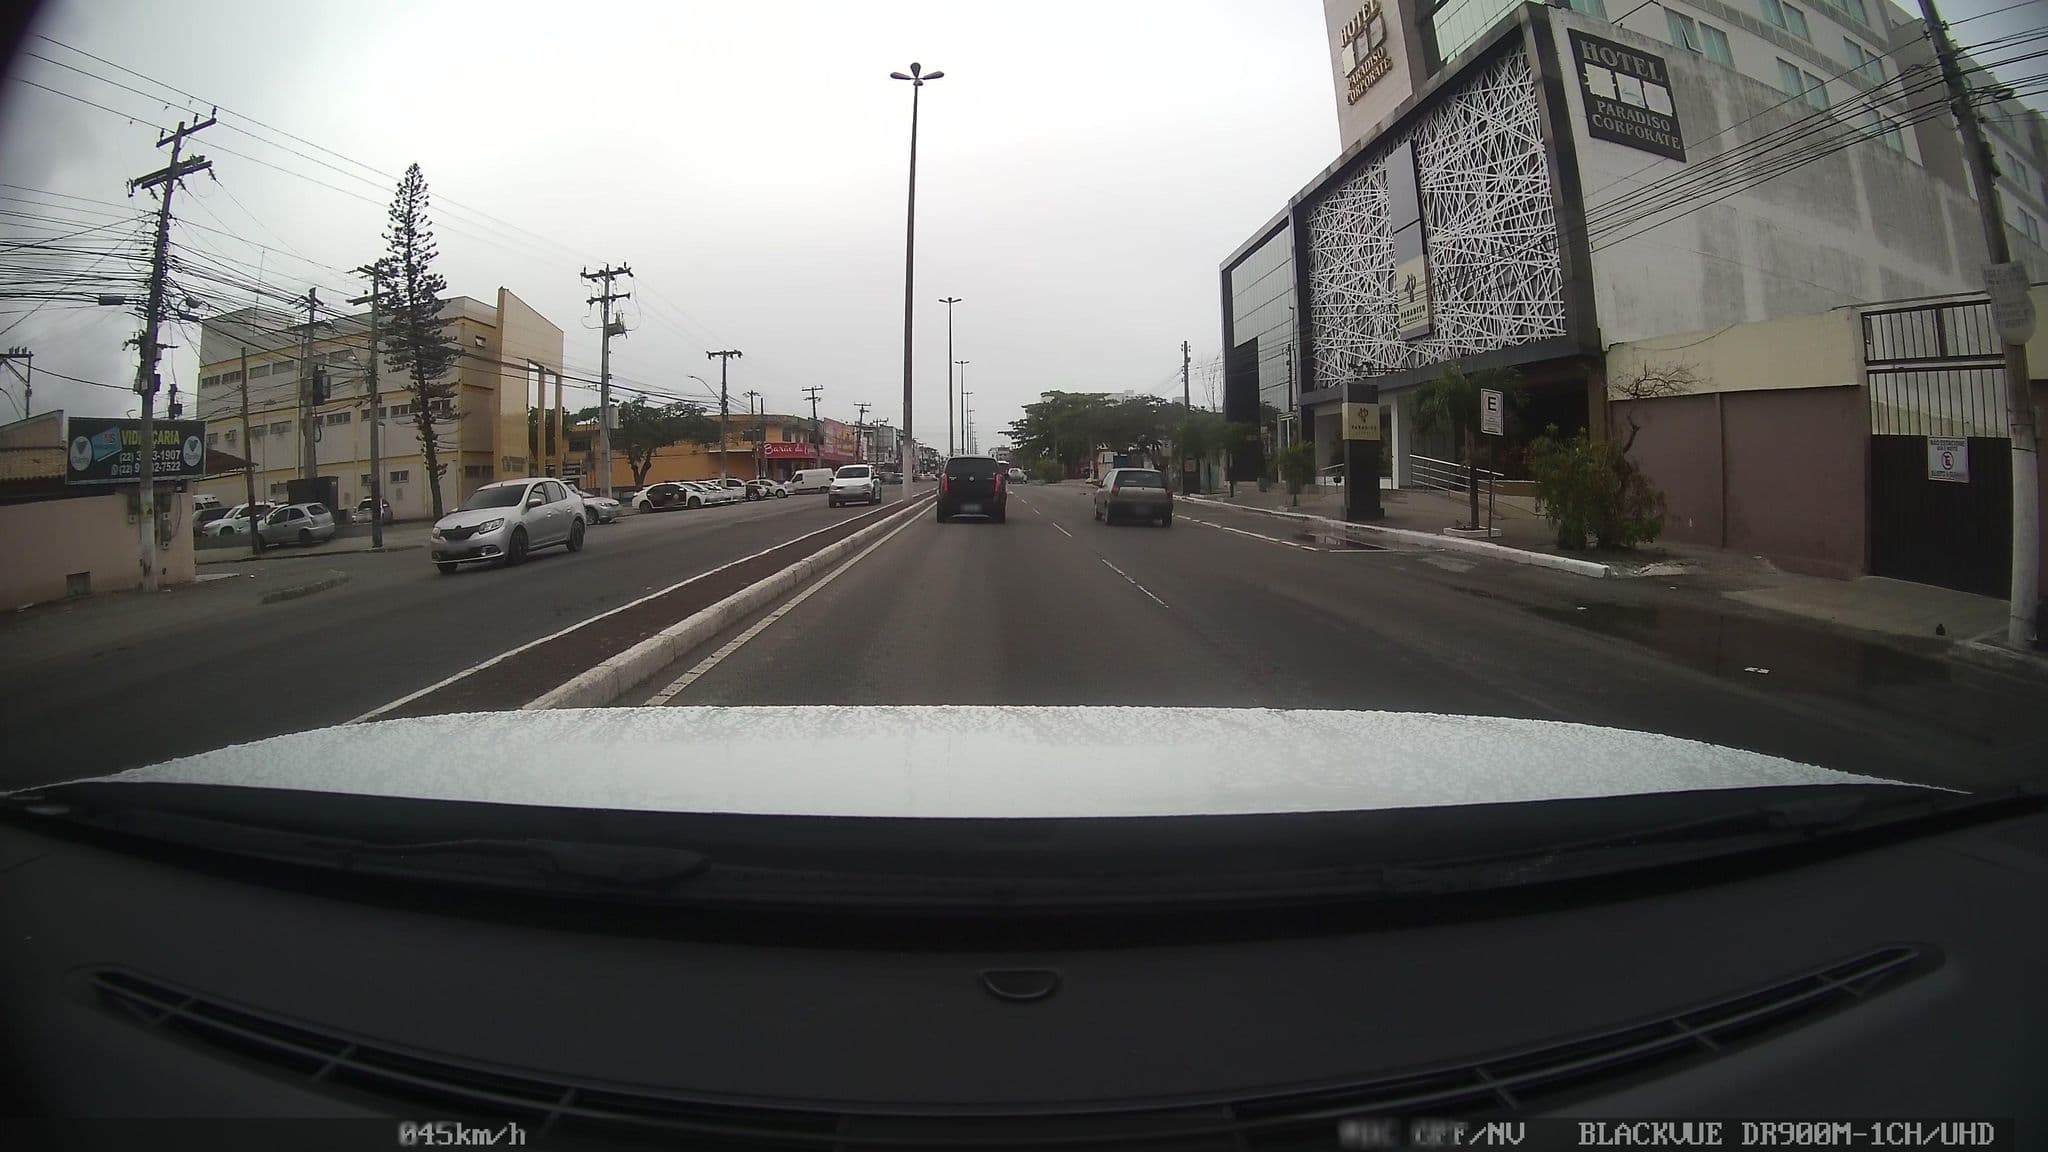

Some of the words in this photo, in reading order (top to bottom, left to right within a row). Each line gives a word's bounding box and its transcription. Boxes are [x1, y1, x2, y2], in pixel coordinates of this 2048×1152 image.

[1340, 0, 1381, 46] HOTEL
[1348, 46, 1384, 90] PARADISO
[1580, 39, 1663, 82] HOTEL
[1347, 56, 1392, 105] CORPORATE
[1591, 113, 1681, 149] CORPORATE
[1597, 100, 1671, 132] PARADISO
[1487, 396, 1497, 411] E
[120, 430, 180, 447] VIDÇARIA
[119, 452, 134, 463] (22)
[135, 450, 181, 461] 33-1907
[119, 464, 133, 475] (22)
